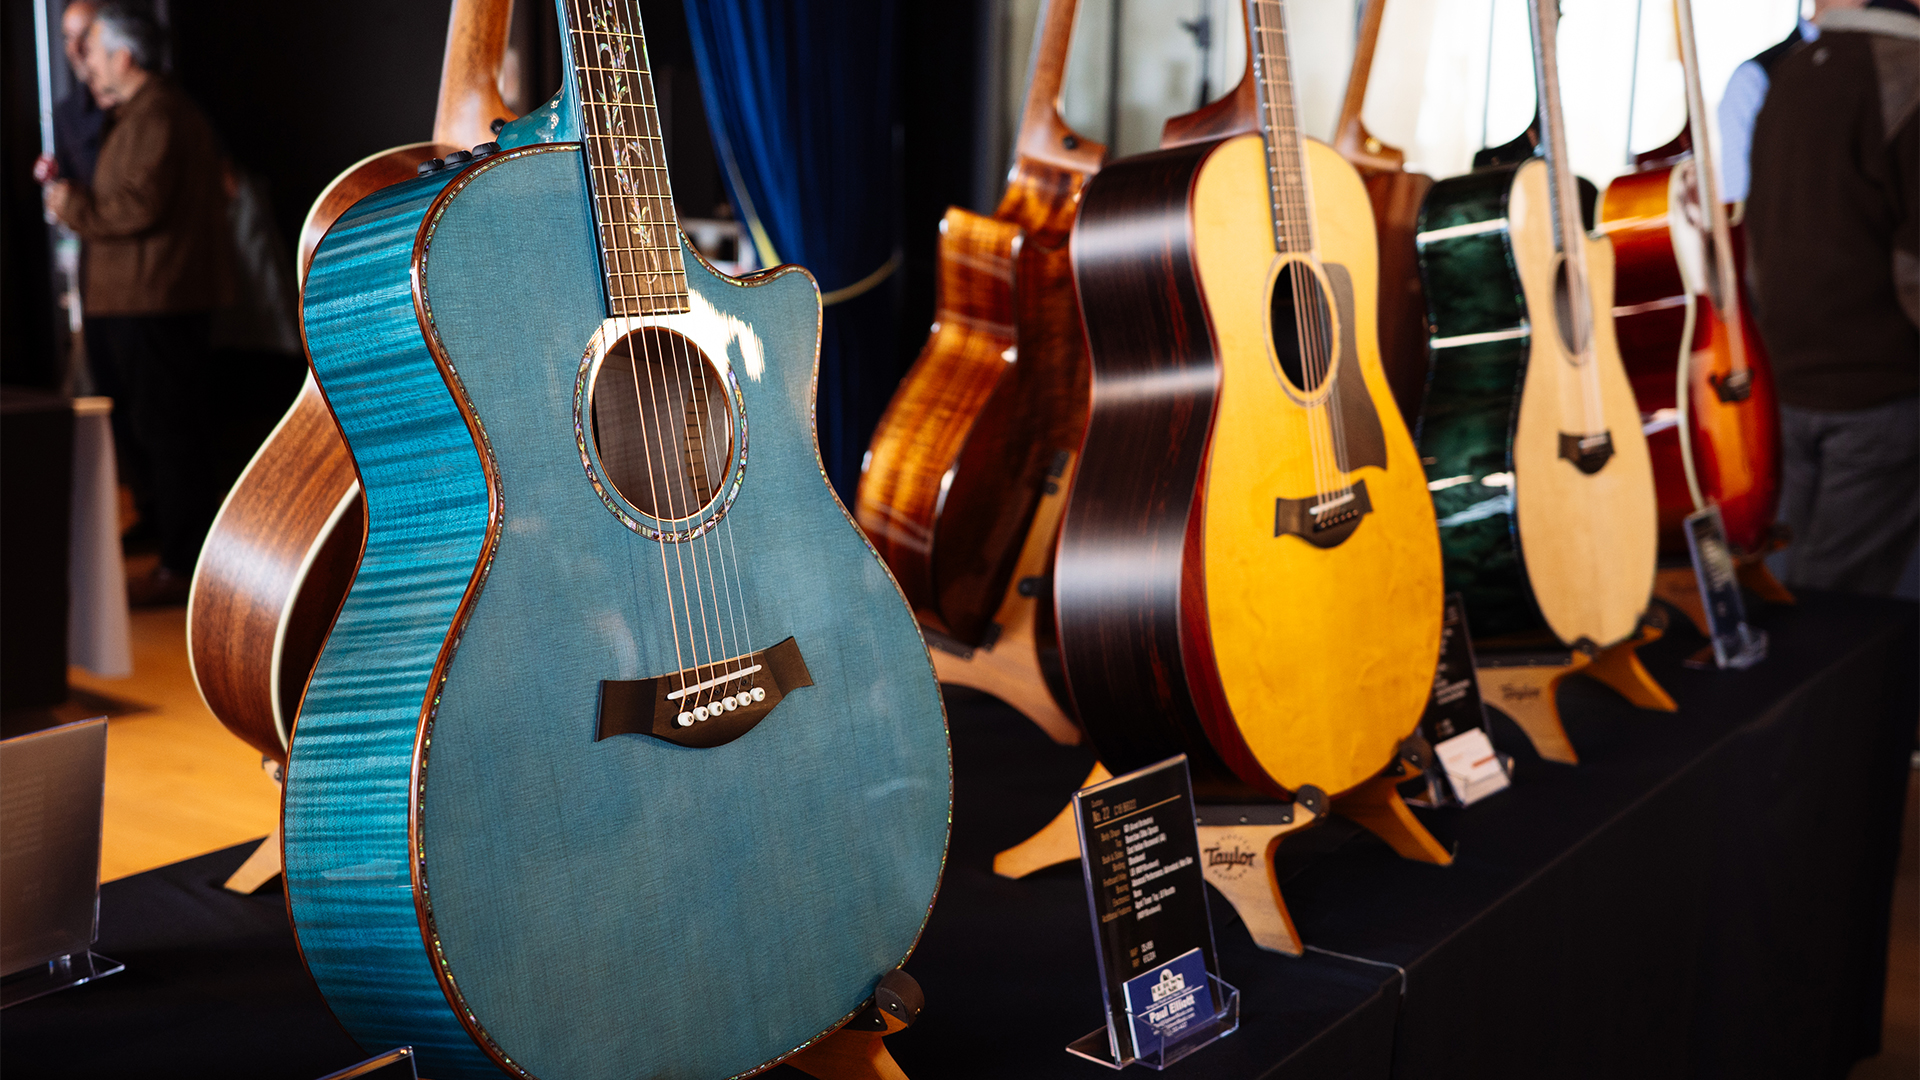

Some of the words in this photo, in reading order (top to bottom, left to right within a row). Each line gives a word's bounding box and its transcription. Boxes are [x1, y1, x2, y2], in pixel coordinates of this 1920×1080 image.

[1204, 846, 1256, 871] Taylor
[1149, 1005, 1169, 1024] Paul
[1169, 994, 1196, 1015] Elliott
